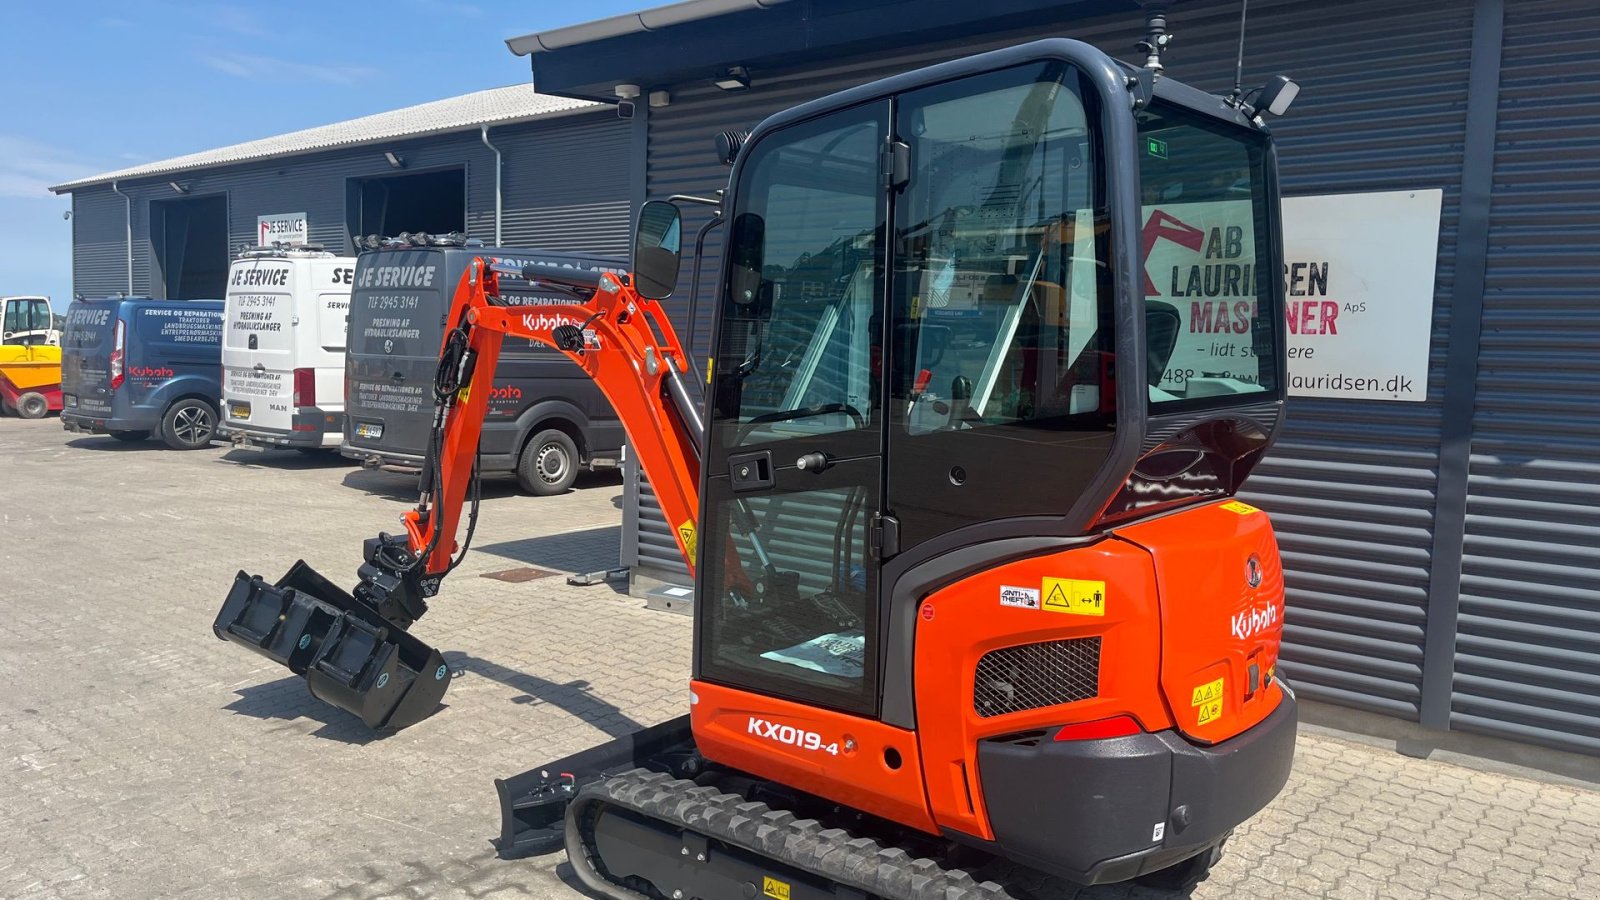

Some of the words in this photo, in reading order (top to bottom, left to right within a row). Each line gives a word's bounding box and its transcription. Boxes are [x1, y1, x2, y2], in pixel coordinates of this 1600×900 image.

[269, 220, 276, 234] JE
[277, 219, 302, 232] SERVICE
[1206, 226, 1242, 259] AB
[232, 269, 242, 286] JE
[244, 268, 288, 286] SERVICE
[358, 267, 374, 287] JE
[374, 266, 436, 288] SERVICE
[1171, 262, 1328, 297] LAURIEN
[246, 296, 261, 307] 2945
[262, 296, 276, 307] 3141
[368, 296, 379, 308] TLF
[380, 296, 398, 310] 2945
[400, 296, 418, 310] 3141
[508, 296, 520, 305] OG
[73, 309, 110, 326] SERVICE
[264, 312, 272, 320] AF
[401, 318, 410, 327] AF
[522, 313, 569, 330] Kubota
[1190, 300, 1339, 335] MASNER
[1344, 302, 1366, 312] ApS
[1210, 342, 1235, 357] lidt
[129, 366, 174, 377] Kubota
[1001, 595, 1024, 603] THEFT
[1231, 602, 1276, 640] Kubota
[747, 717, 838, 756] KX019-4
